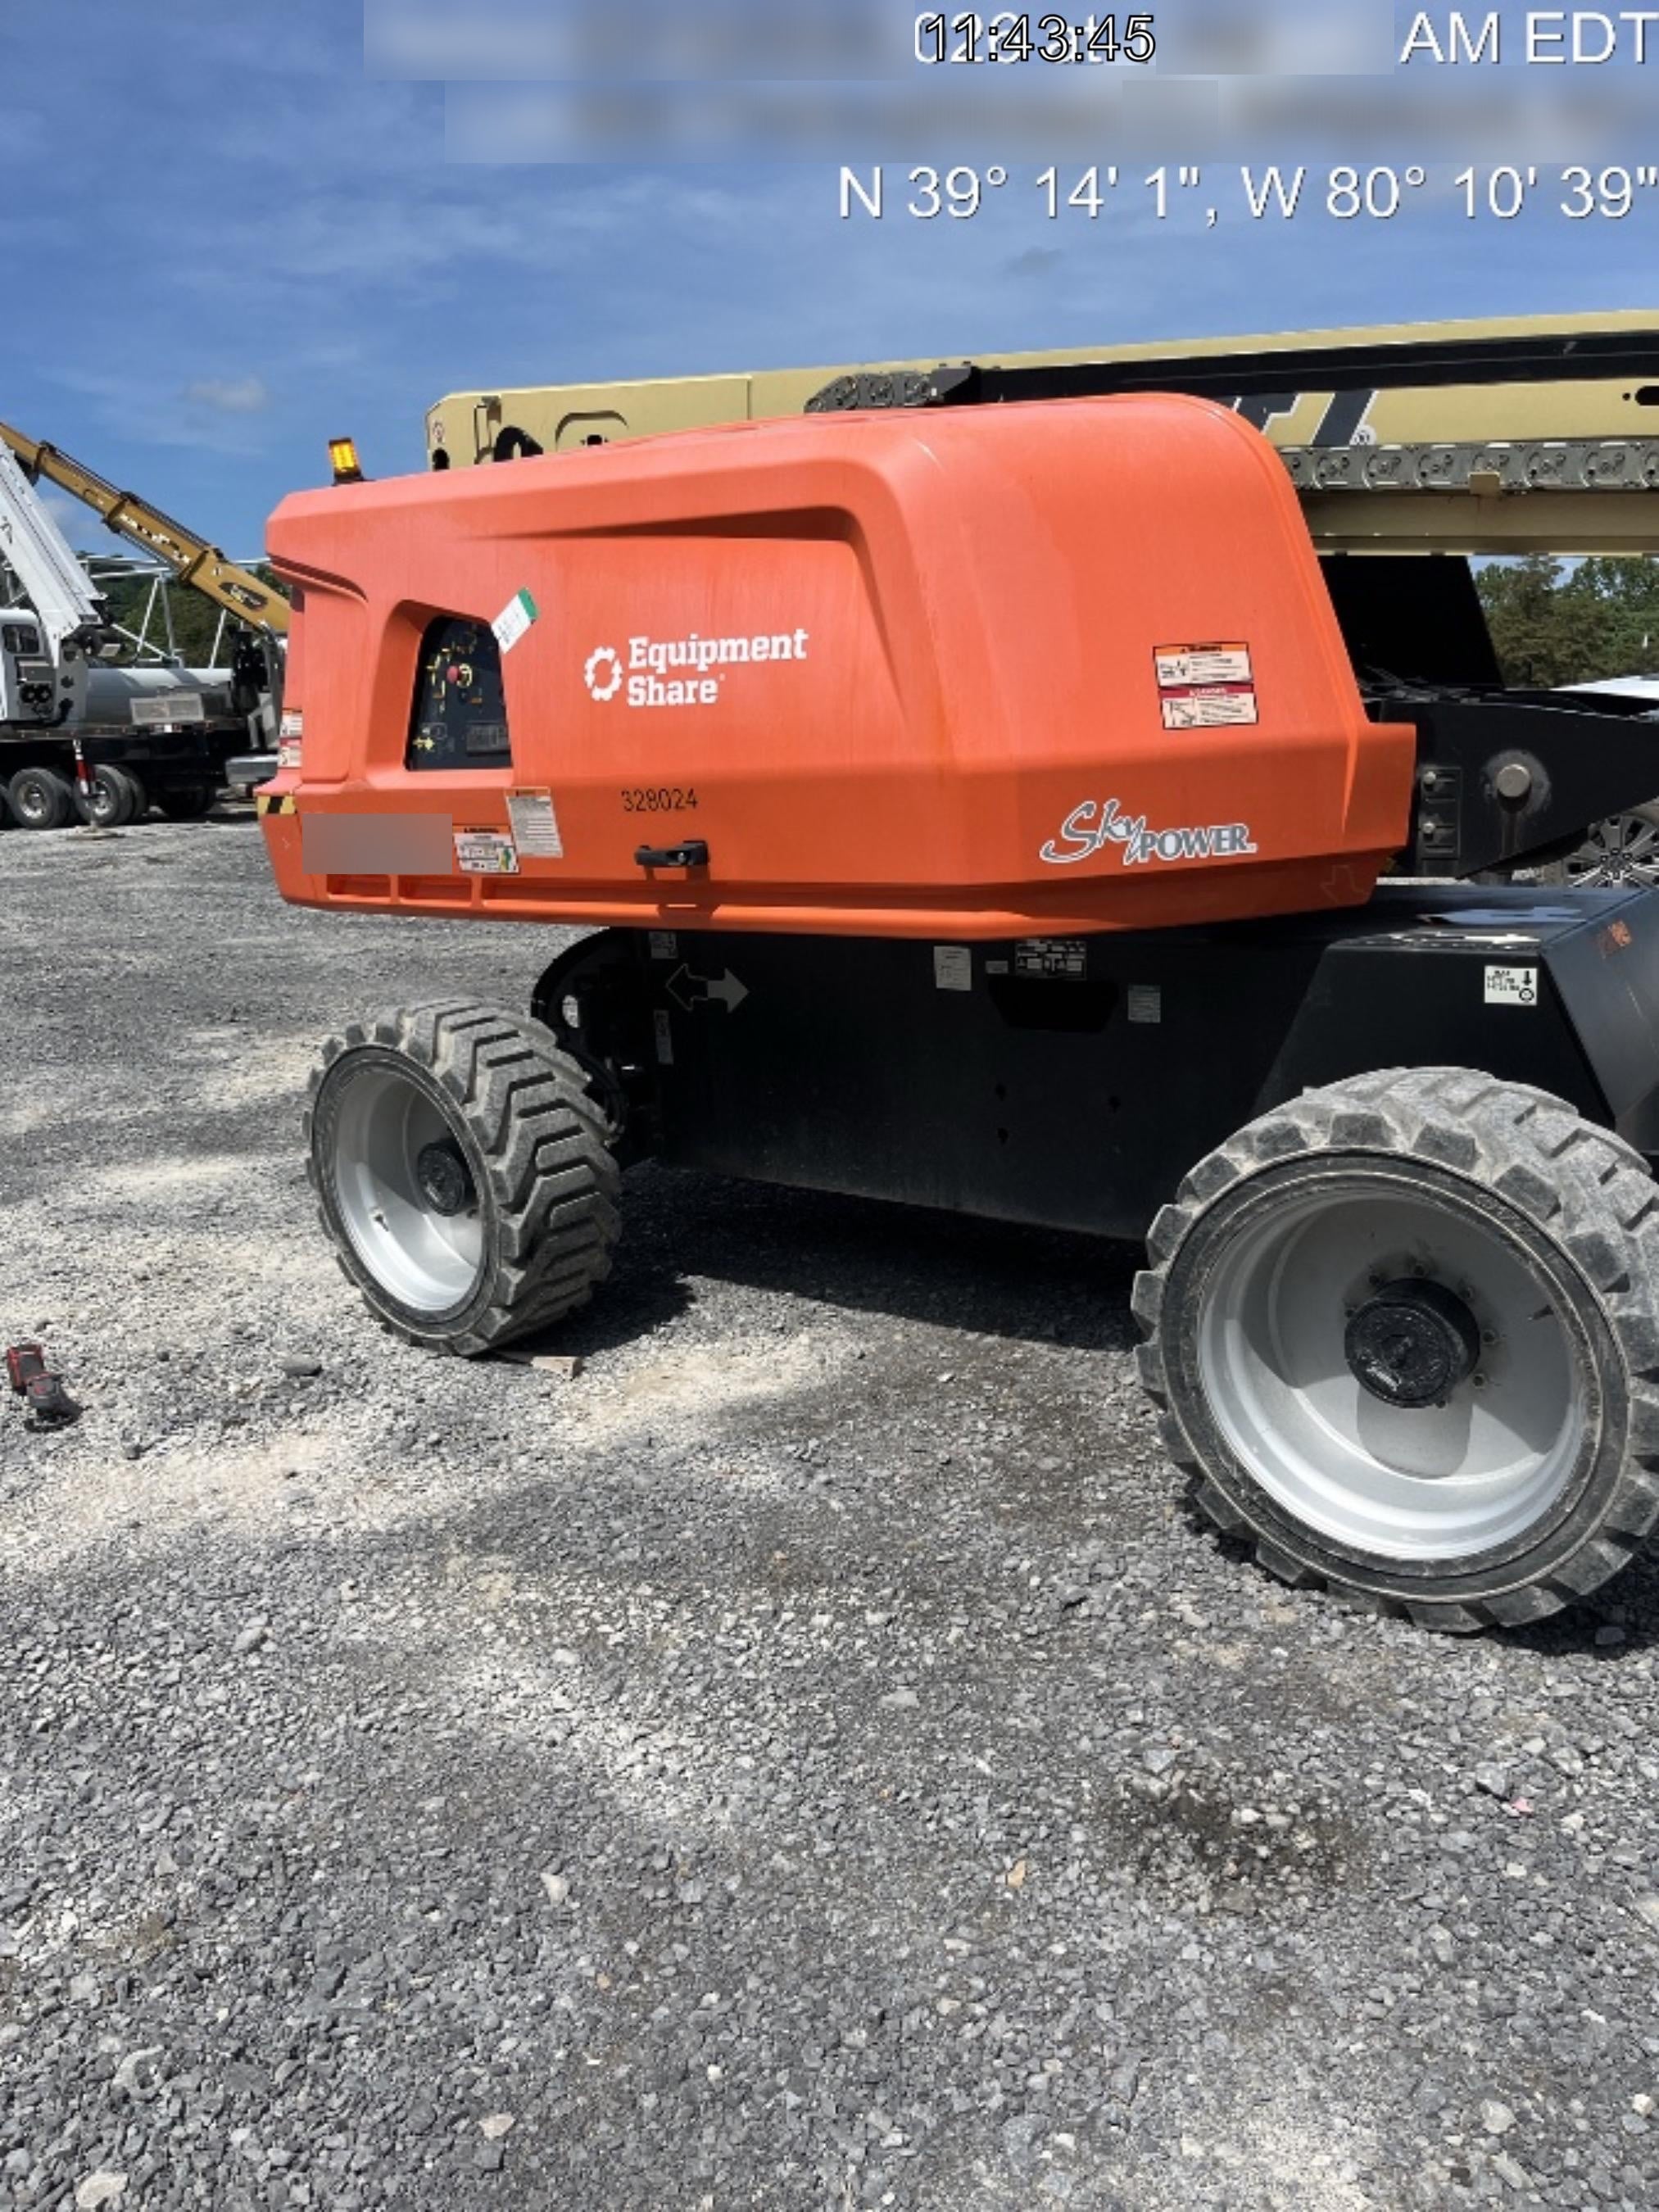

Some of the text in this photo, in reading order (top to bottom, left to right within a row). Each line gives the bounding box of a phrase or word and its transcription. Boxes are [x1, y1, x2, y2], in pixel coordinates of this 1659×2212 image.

[628, 628, 809, 674] Equipment
[627, 675, 718, 707] Share
[621, 788, 698, 812] 328024
